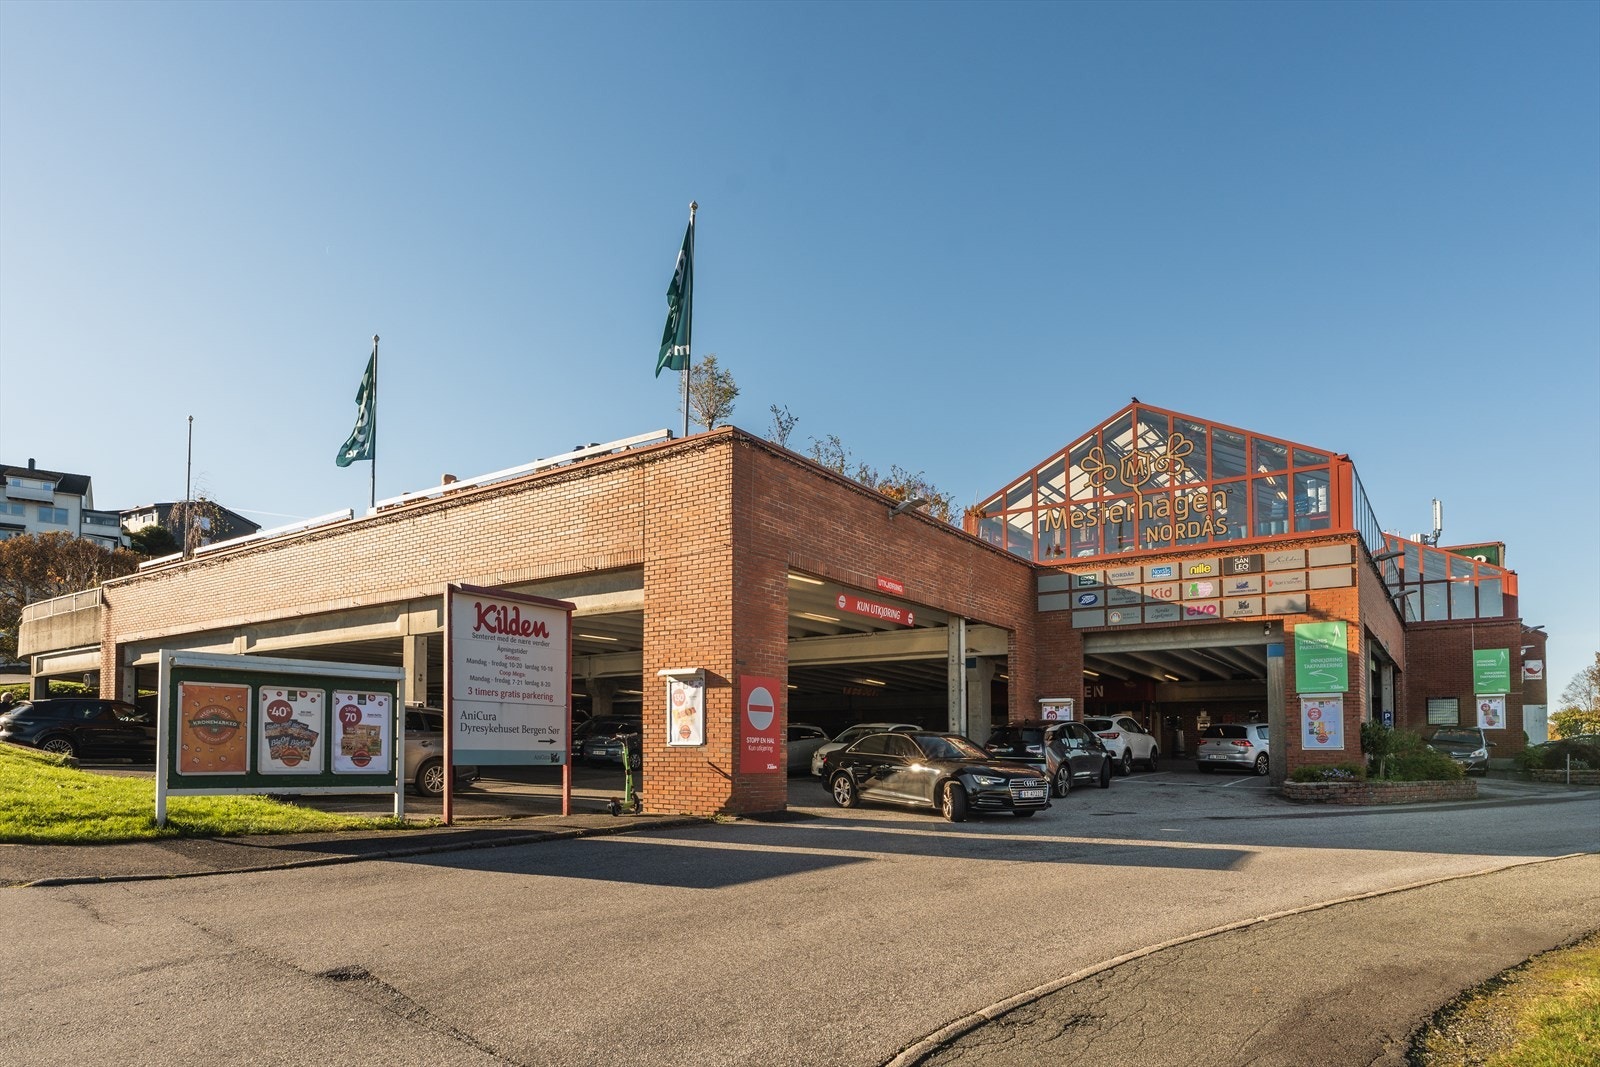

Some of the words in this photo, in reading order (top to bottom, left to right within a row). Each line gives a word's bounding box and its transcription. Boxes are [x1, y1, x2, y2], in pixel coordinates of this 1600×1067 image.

[1126, 459, 1144, 479] M
[1045, 489, 1227, 533] Mesterhagen
[1146, 514, 1228, 543] NORDÅS
[1189, 563, 1211, 575] nille
[1151, 587, 1172, 599] Kid
[857, 600, 870, 611] KUN
[870, 604, 900, 619] UTKJØRING
[1186, 604, 1217, 616] evo
[473, 602, 549, 638] Kilden
[472, 632, 496, 641] Senteret
[497, 645, 528, 655] Åpningstider
[466, 658, 487, 667] Mandag
[491, 660, 508, 669] fredag
[525, 664, 539, 672] lørdag
[469, 675, 490, 684] Mandag
[494, 677, 510, 685] fredag
[525, 679, 539, 687] lørdag
[468, 686, 473, 695] 3
[475, 688, 499, 697] timers
[500, 690, 520, 699] gratis
[522, 692, 554, 702] parkering
[344, 712, 357, 722] 70
[460, 710, 497, 721] AniCura
[460, 722, 519, 735] Dyresykehuset
[521, 725, 547, 736] Bergen
[547, 726, 560, 735] Sør
